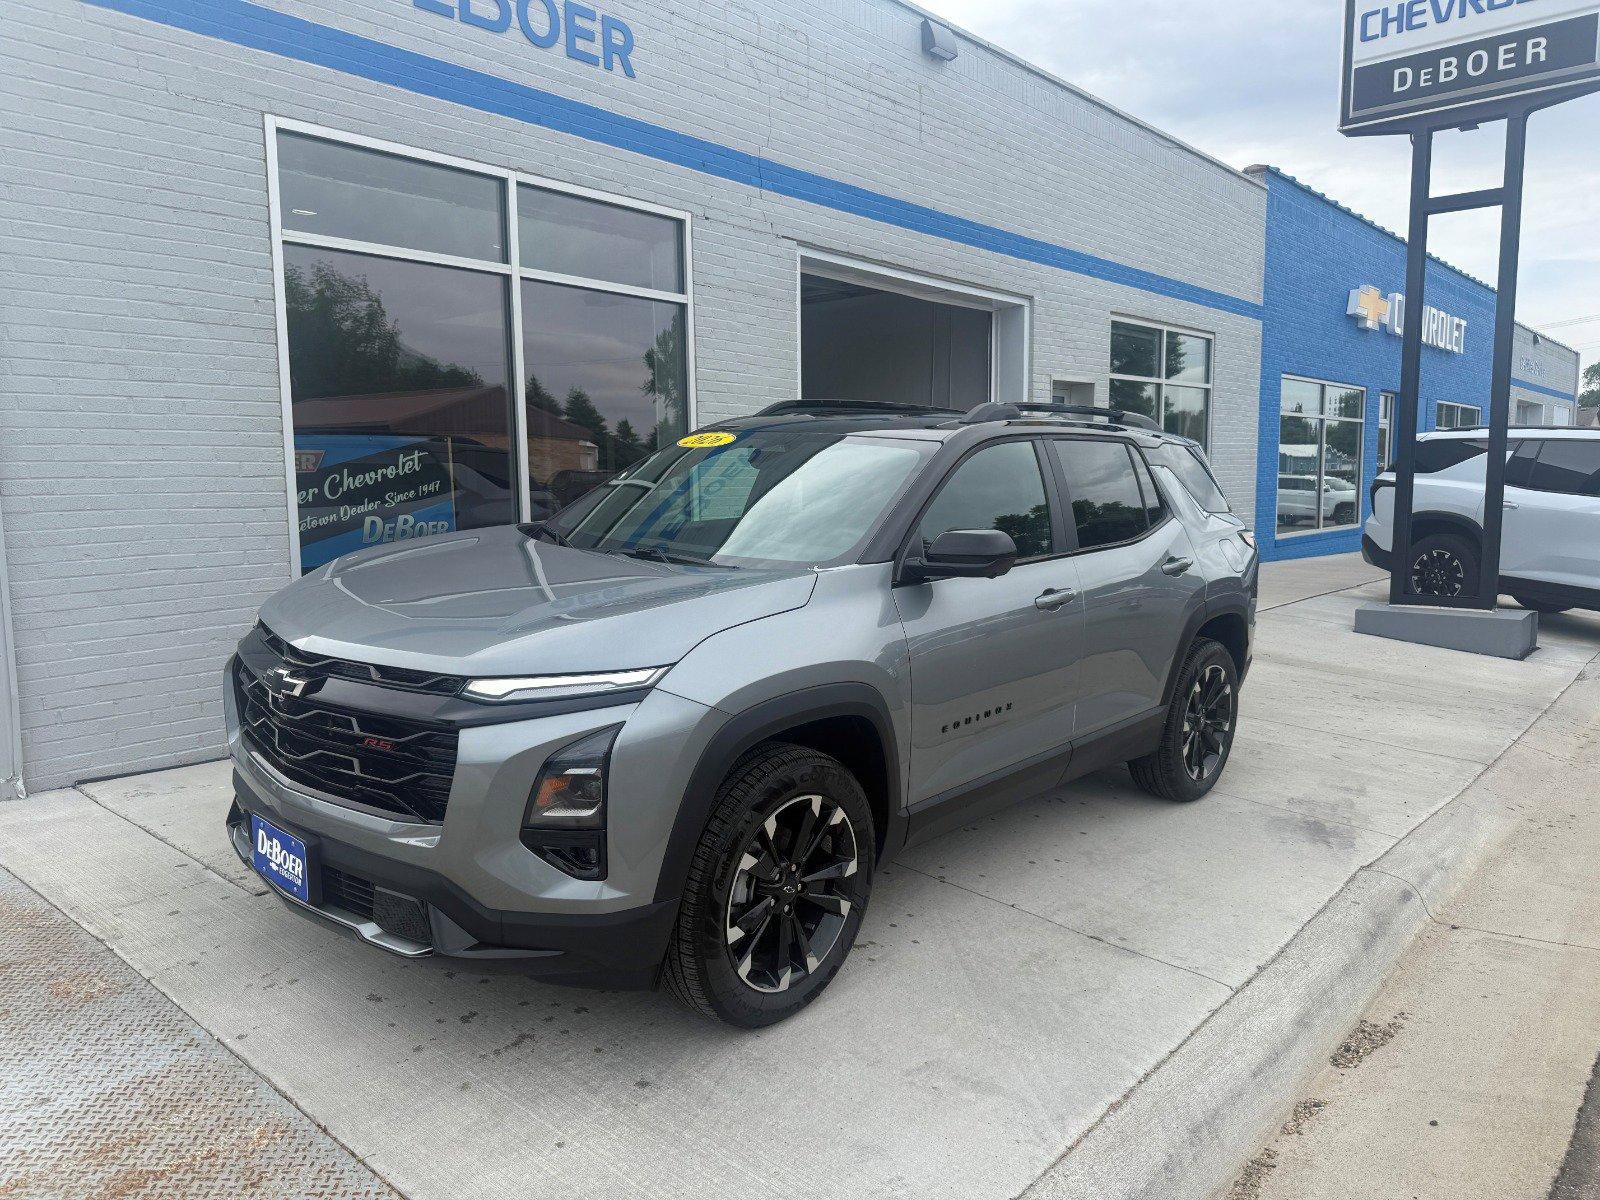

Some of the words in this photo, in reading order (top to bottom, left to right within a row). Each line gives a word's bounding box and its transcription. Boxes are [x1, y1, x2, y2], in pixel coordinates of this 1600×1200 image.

[324, 450, 429, 500] Chevrolet
[340, 498, 381, 521] Dealer
[384, 489, 417, 508] Since
[418, 480, 441, 497] 1947
[941, 702, 1013, 734] EQUINOX
